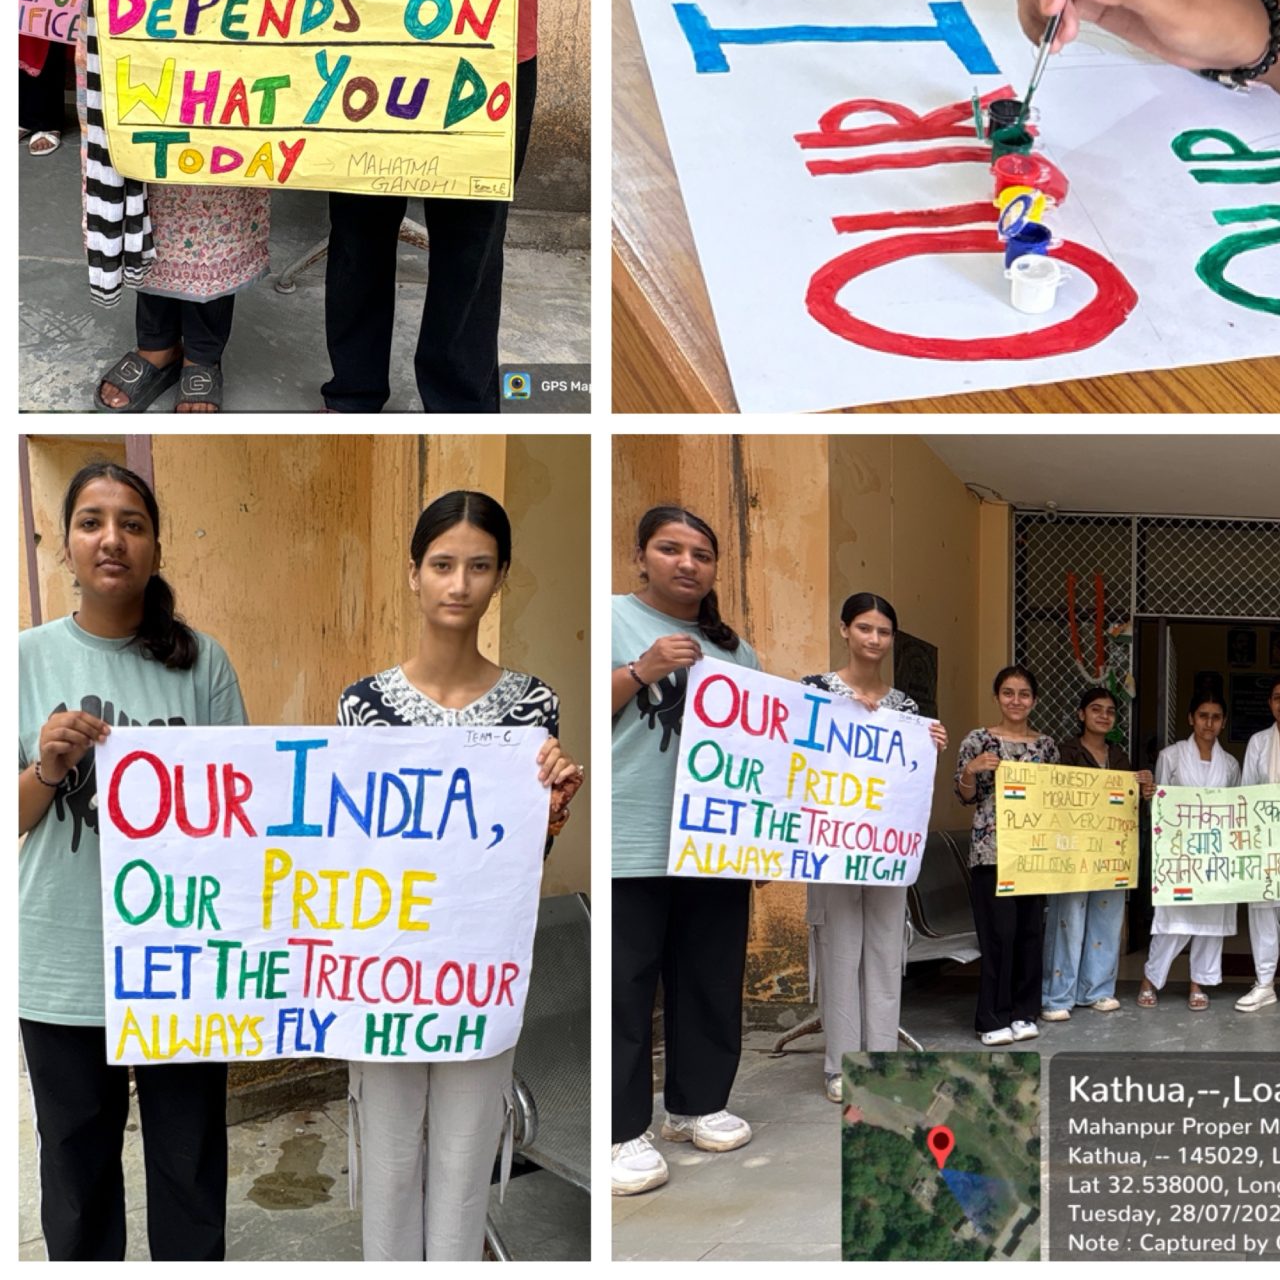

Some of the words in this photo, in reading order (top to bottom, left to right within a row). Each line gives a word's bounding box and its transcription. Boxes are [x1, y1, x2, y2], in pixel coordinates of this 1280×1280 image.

[115, 55, 291, 127] WHAT
[303, 48, 431, 126] YOU
[443, 56, 512, 130] DO
[132, 131, 306, 184] TODAY
[347, 151, 440, 177] MAHATMA
[371, 176, 457, 194] GANDHI
[693, 673, 789, 744] OUR
[793, 692, 918, 773] INDIA,
[107, 750, 257, 840] OUR
[266, 739, 505, 850] INDIA,
[1003, 809, 1043, 830] PLAY
[1050, 813, 1062, 828] A
[1068, 812, 1106, 830] VERY
[676, 835, 784, 878] ALWAYS
[790, 849, 829, 880] FLY
[845, 854, 907, 882] HIGH
[114, 859, 221, 931] OUR
[262, 848, 437, 931] PRIDE
[114, 945, 202, 1000] LET
[207, 939, 290, 1000] THE
[287, 937, 520, 1008] TRICOLOUR
[115, 1006, 264, 1061] ALWAYS
[276, 1007, 337, 1054] FLY
[364, 1012, 487, 1057] HIGH
